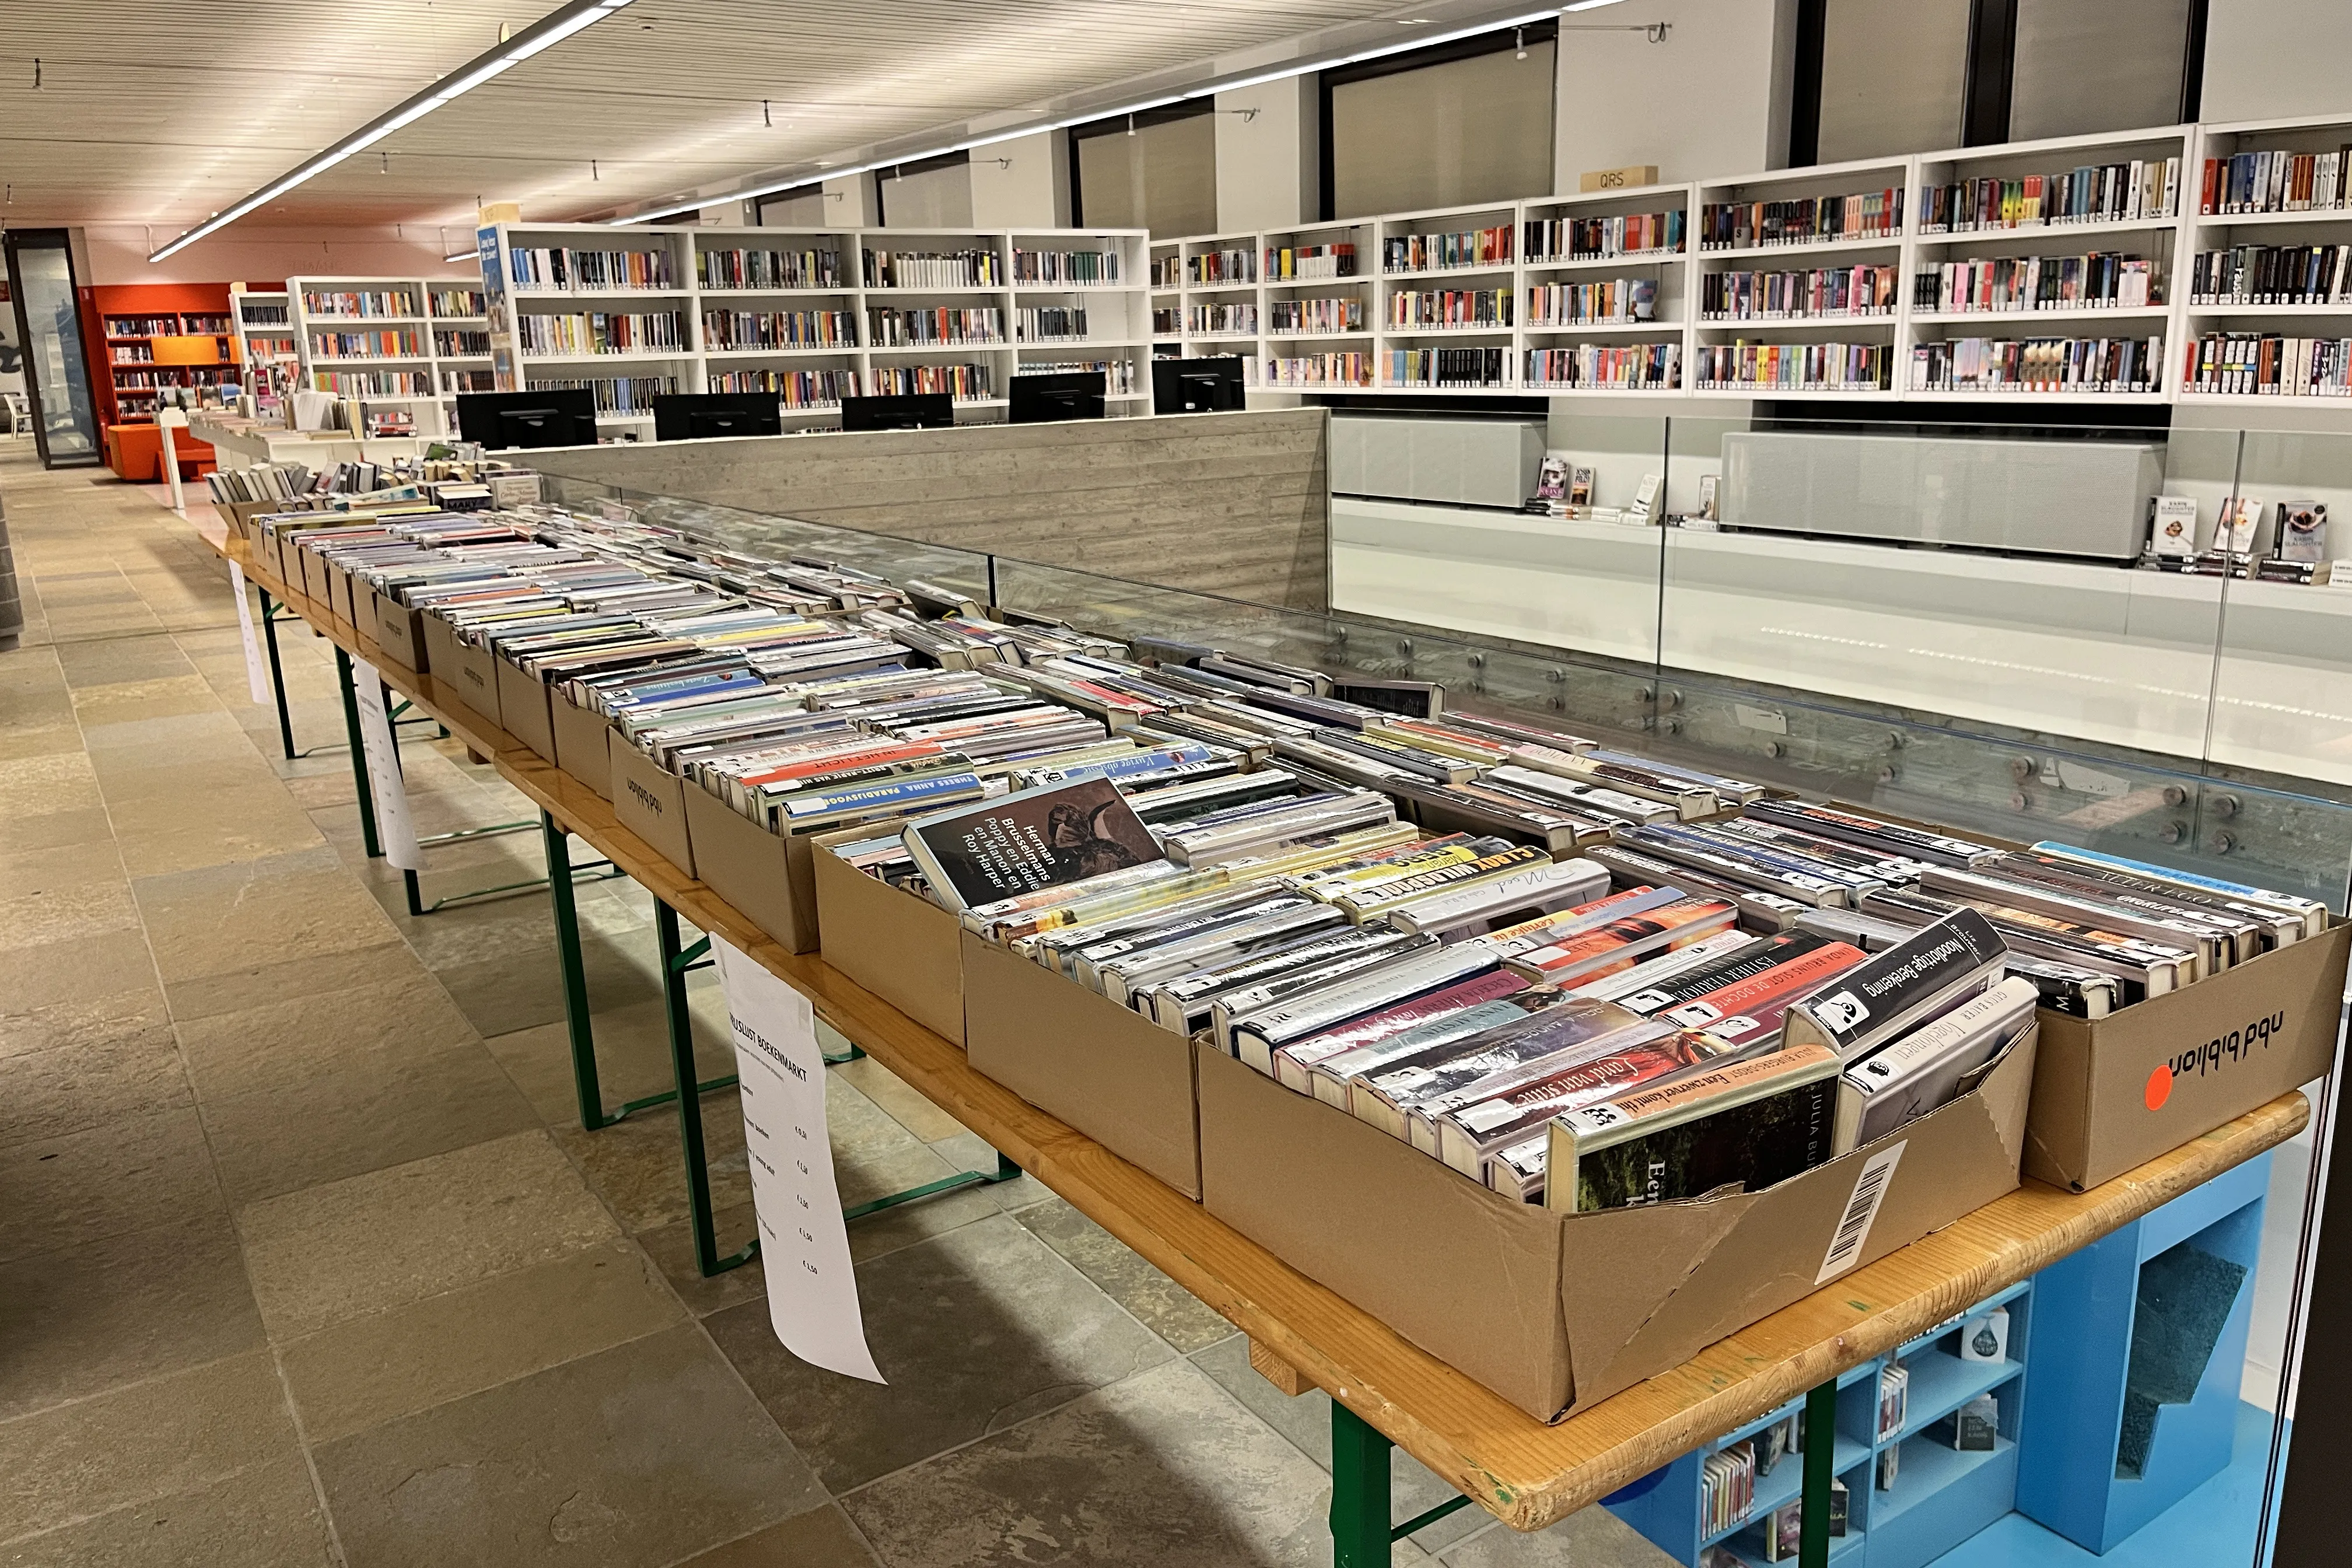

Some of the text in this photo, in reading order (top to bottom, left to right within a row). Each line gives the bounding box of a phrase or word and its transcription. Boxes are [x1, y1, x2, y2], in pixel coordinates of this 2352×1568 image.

[1600, 172, 1623, 188] QRS
[905, 782, 935, 792] ANNA
[938, 775, 974, 787] THREES
[985, 817, 1040, 890] Poppy en Eddie
[1002, 818, 1051, 881] Brusselmans
[1024, 825, 1056, 865] Herman
[962, 834, 1006, 888] Roy Harper
[974, 827, 1021, 889] en Manon en
[1426, 855, 1464, 869] Marian
[1478, 852, 1512, 870] BOX
[1508, 918, 1556, 939] Eerlijke
[1965, 930, 1977, 943] Liz
[1950, 923, 1981, 956] Brouwer
[1726, 956, 1778, 982] ESTHER
[1794, 955, 1827, 977] BRUINS
[1862, 938, 1965, 998] Noodlottige Berekening
[1756, 980, 1772, 992] DE
[1772, 970, 1796, 986] SLOT
[1419, 978, 1513, 1011] CECELIA AHERN
[1471, 1004, 1511, 1021] LYNN
[1422, 1016, 1471, 1038] AUSTIN
[1895, 1021, 1966, 1060] Vogeljongen
[2167, 1010, 2284, 1078] nbd biblion
[758, 1034, 807, 1083] BOEKENMARKT
[1596, 1056, 1639, 1080] Land
[1558, 1071, 1591, 1091] van
[1664, 1077, 1707, 1097] zwerver
[1707, 1073, 1731, 1086] Een
[1637, 1091, 1671, 1108] komt
[1808, 1094, 1822, 1136] JULIA
[800, 1198, 809, 1210] 1,50
[802, 1230, 813, 1242] 1,50
[806, 1262, 818, 1275] 1,50
